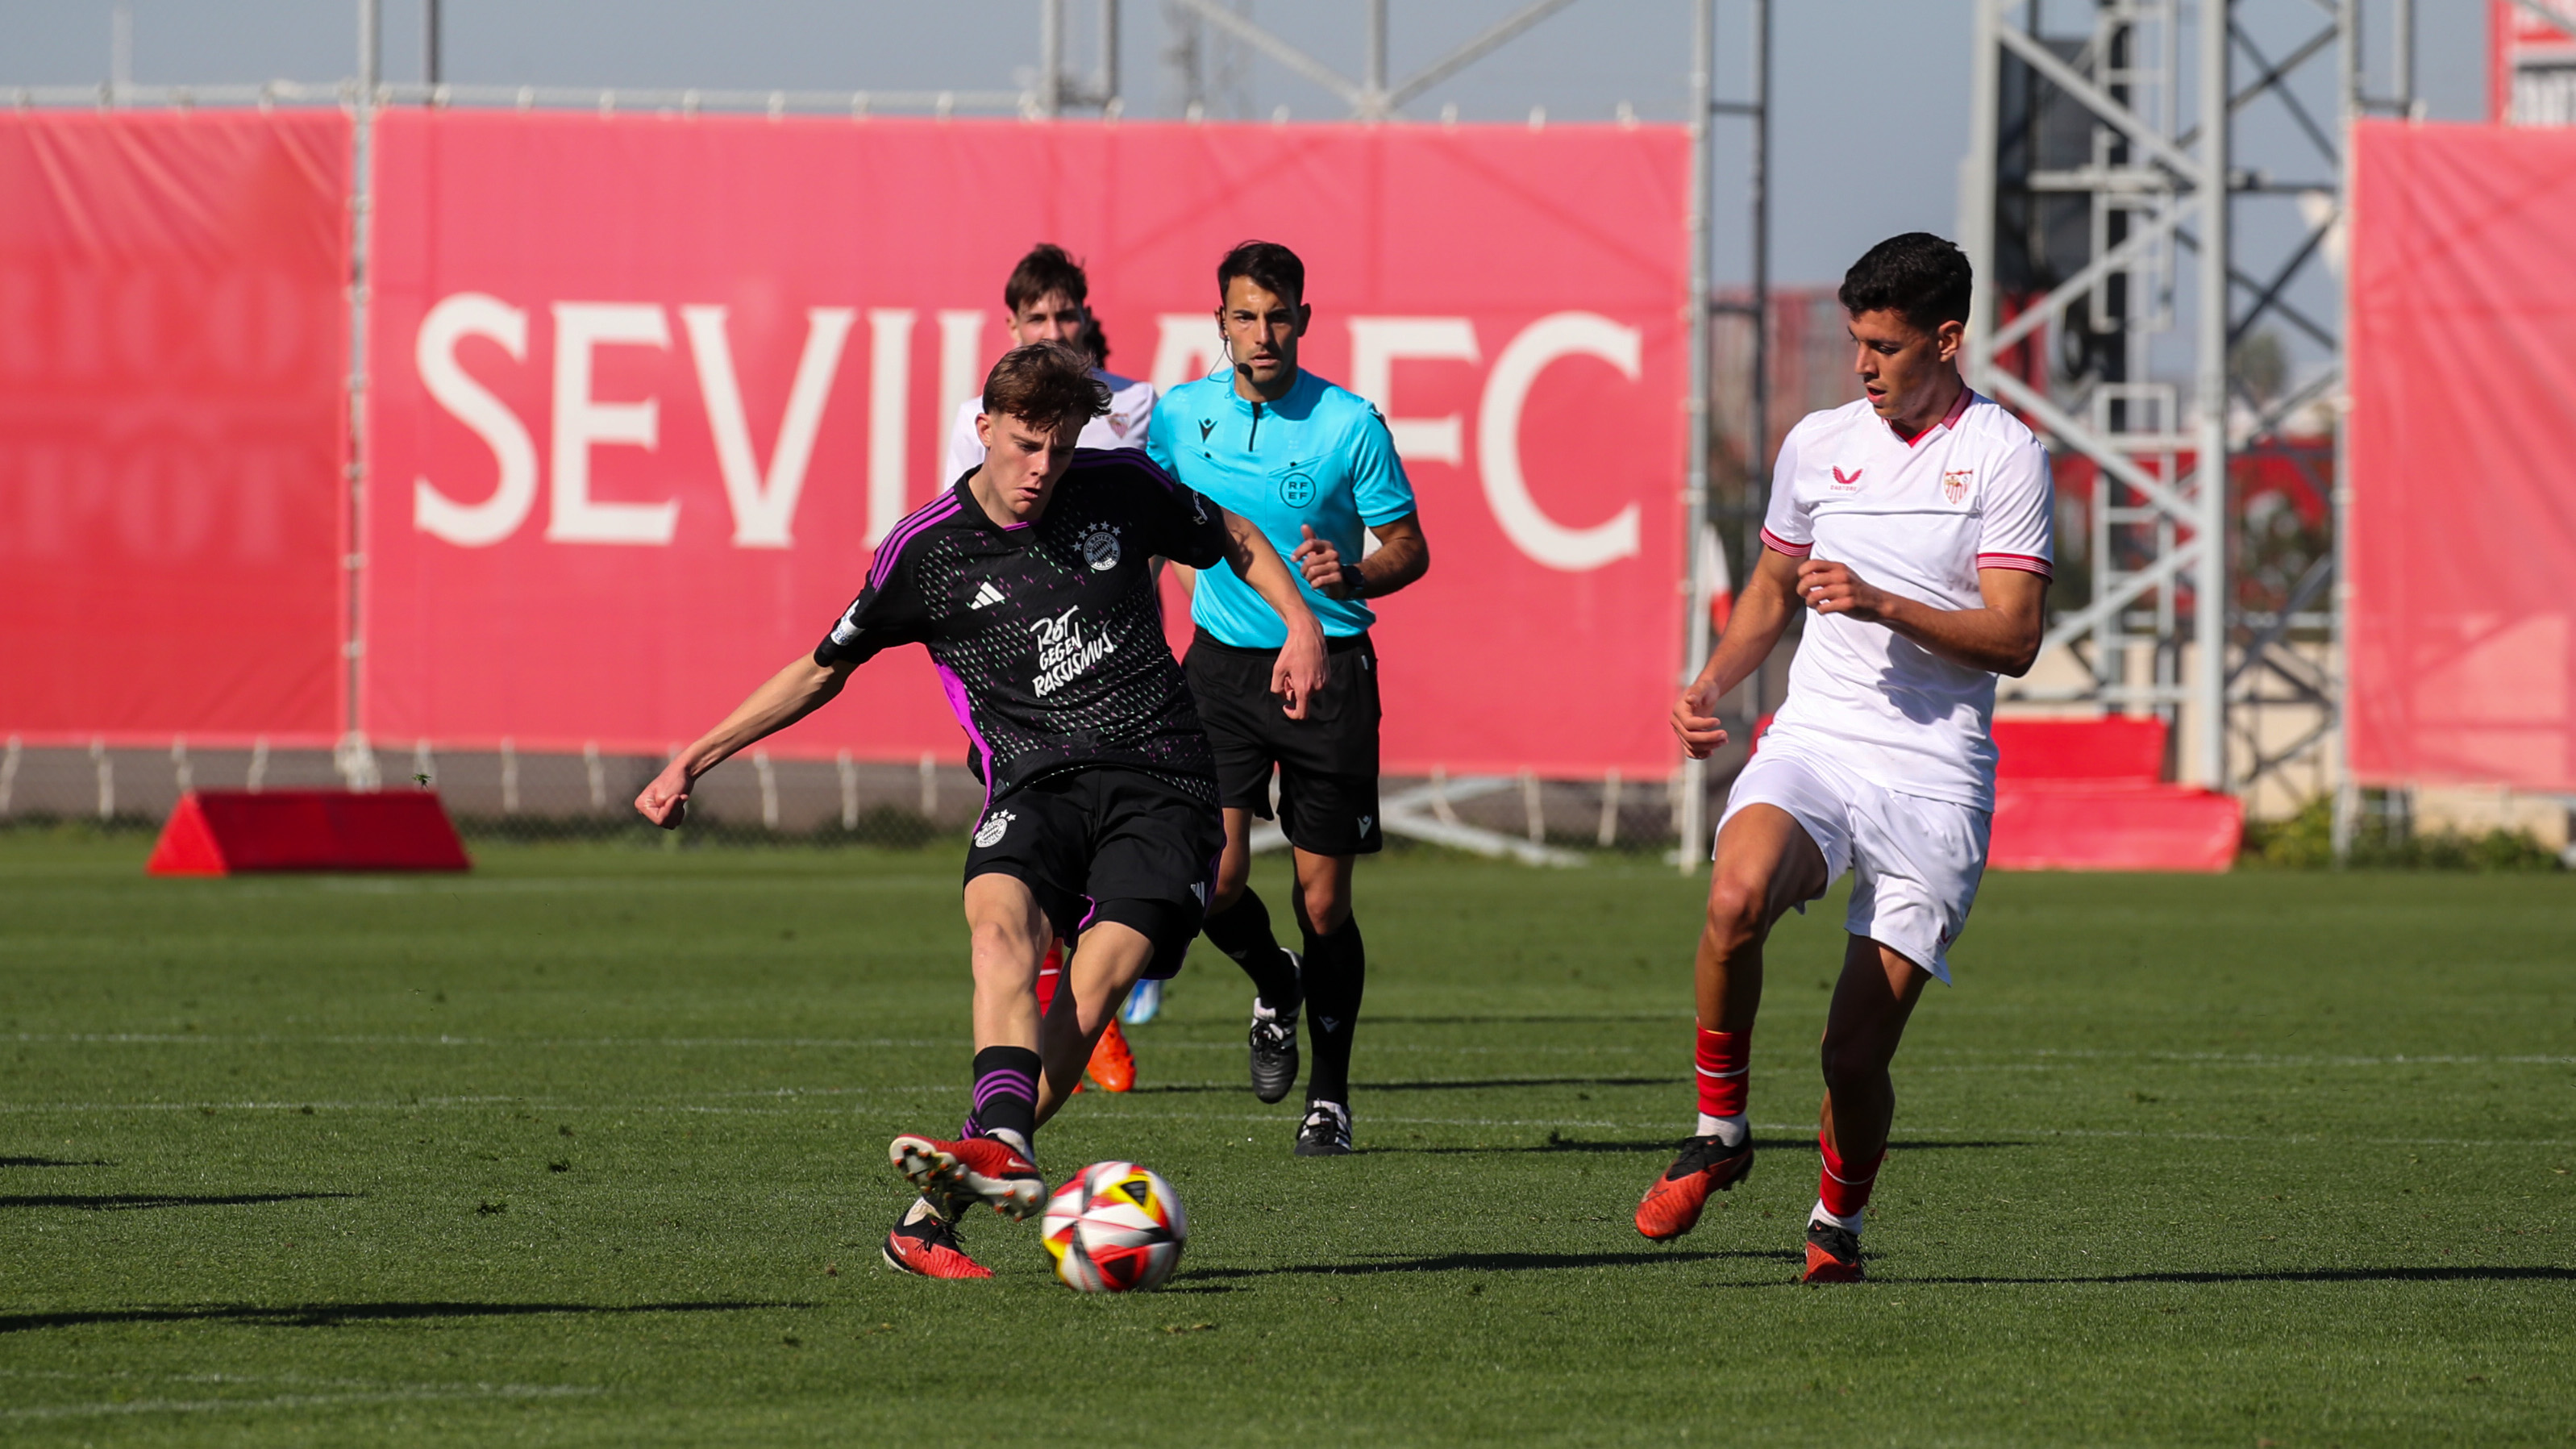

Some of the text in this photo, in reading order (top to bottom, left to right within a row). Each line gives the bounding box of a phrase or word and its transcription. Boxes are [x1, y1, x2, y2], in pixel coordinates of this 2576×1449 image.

[414, 290, 1642, 572] SEVI FC
[1090, 535, 1114, 544] BAYERN
[1030, 605, 1080, 652] ROT
[1039, 622, 1082, 671] GEGEN
[1032, 619, 1114, 698] RASSISMUS
